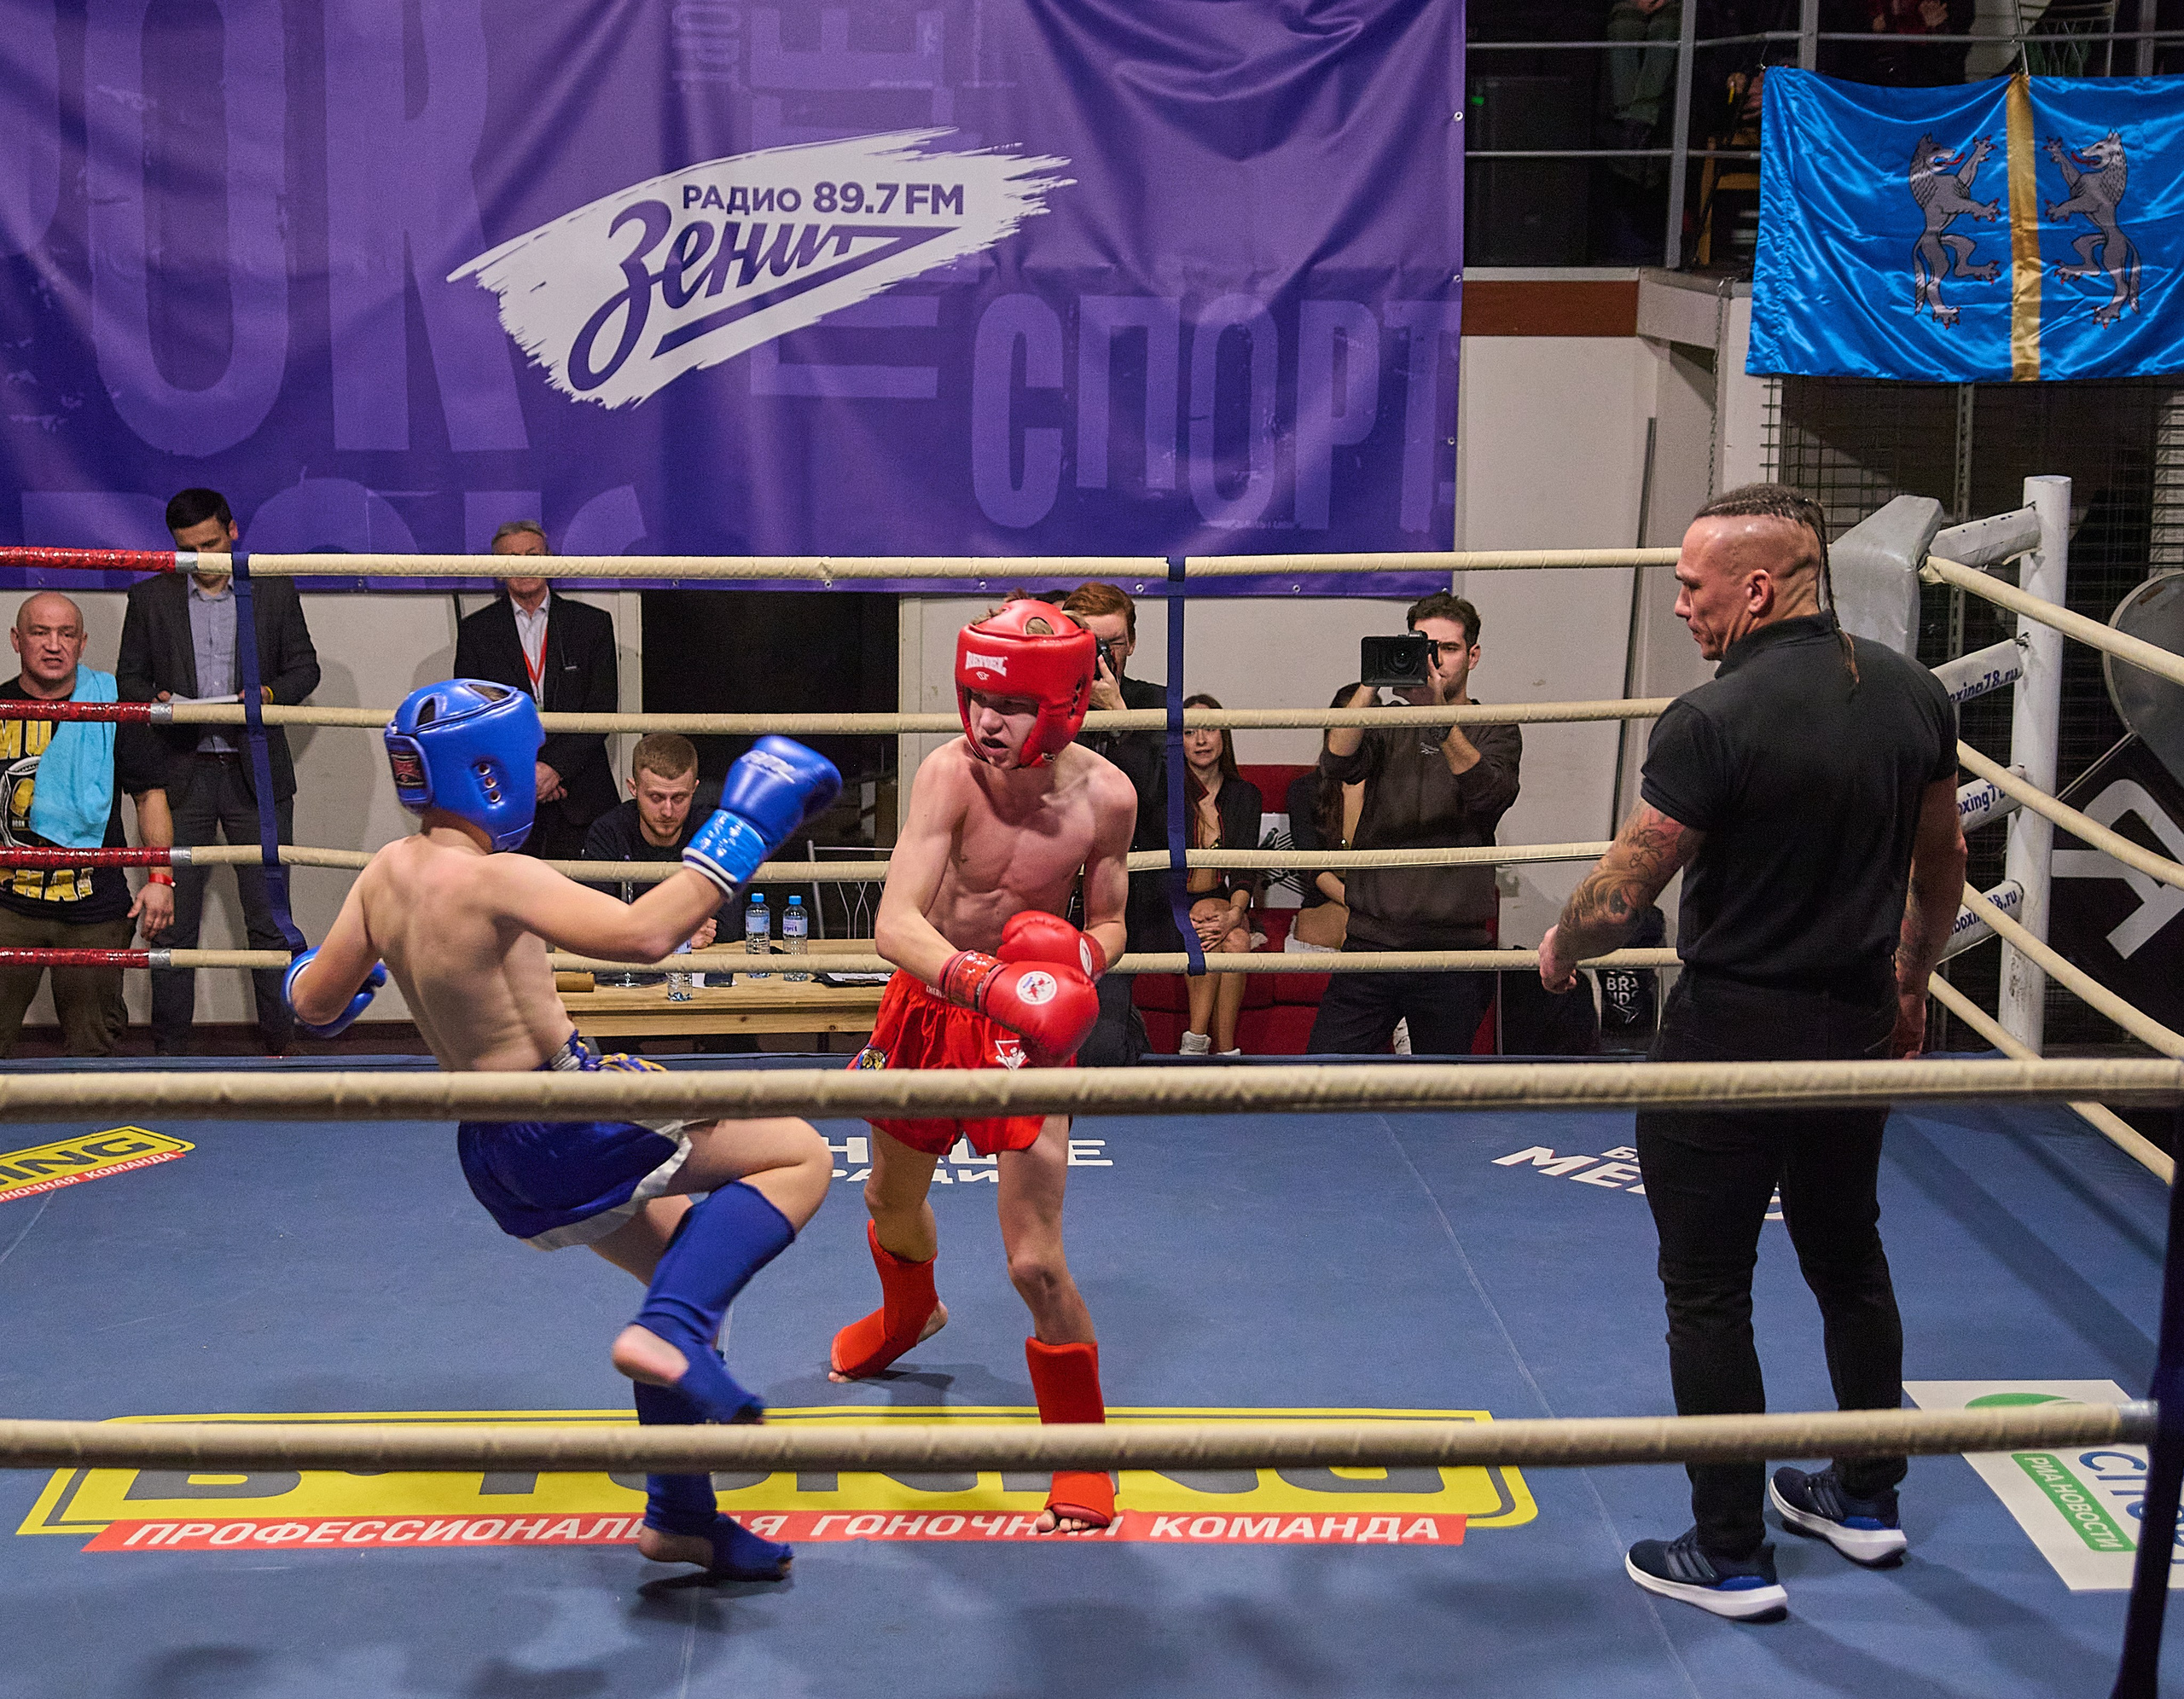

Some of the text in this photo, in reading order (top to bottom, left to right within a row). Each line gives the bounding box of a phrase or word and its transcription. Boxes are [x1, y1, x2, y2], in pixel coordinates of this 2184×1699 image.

[683, 185, 801, 215] РАДИО
[567, 200, 962, 391] Зенит
[972, 293, 1462, 534] СПОРТ
[85, 1152, 177, 1180] КОМАНДА
[124, 1515, 788, 1545] ПРОФЕССИОНАЛЯ
[1149, 1516, 1439, 1541] КОМАНДА
[2024, 1457, 2123, 1549] РИА НОВОСТИ
